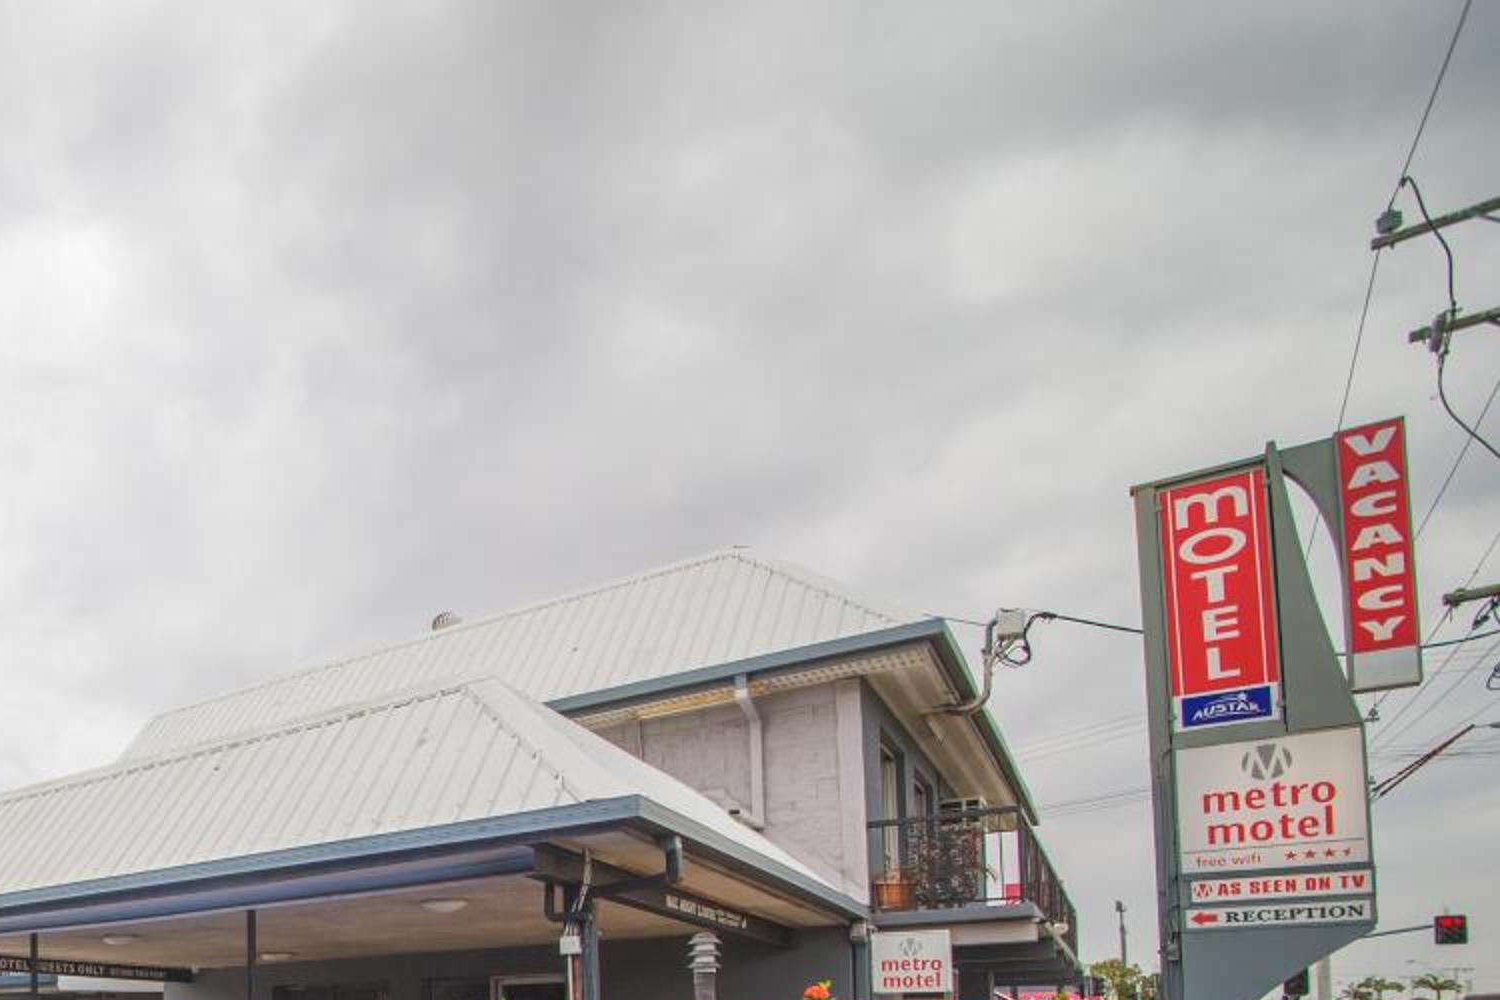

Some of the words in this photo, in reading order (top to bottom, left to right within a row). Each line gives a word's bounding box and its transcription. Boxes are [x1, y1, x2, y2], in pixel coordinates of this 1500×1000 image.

[1344, 426, 1406, 641] VACANCY
[1202, 780, 1336, 814] metro
[1207, 805, 1335, 845] motel
[1196, 854, 1227, 867] free
[1231, 853, 1261, 865] wifi
[1217, 882, 1241, 897] AS
[1249, 878, 1297, 895] SEEN
[1305, 877, 1331, 892] ON
[1340, 874, 1365, 889] TV
[1225, 904, 1365, 924] RECEPTION
[881, 958, 942, 971] metro
[883, 971, 941, 988] motel
